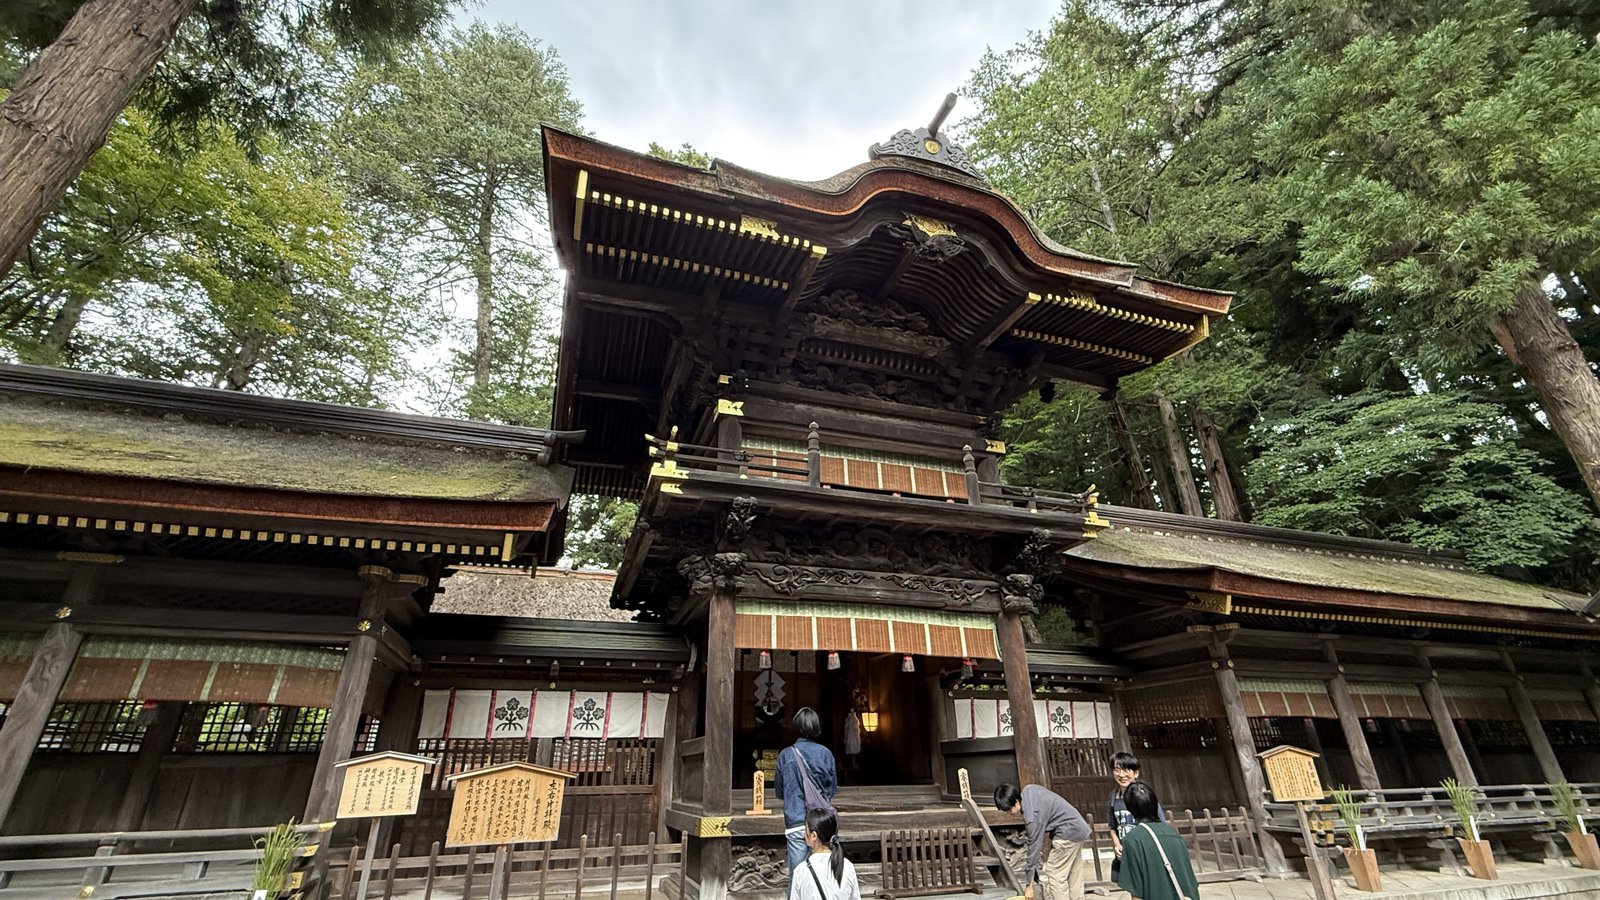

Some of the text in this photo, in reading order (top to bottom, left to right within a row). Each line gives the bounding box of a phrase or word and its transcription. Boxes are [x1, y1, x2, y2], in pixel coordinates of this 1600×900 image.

[541, 779, 558, 830] 左右片拝殿
